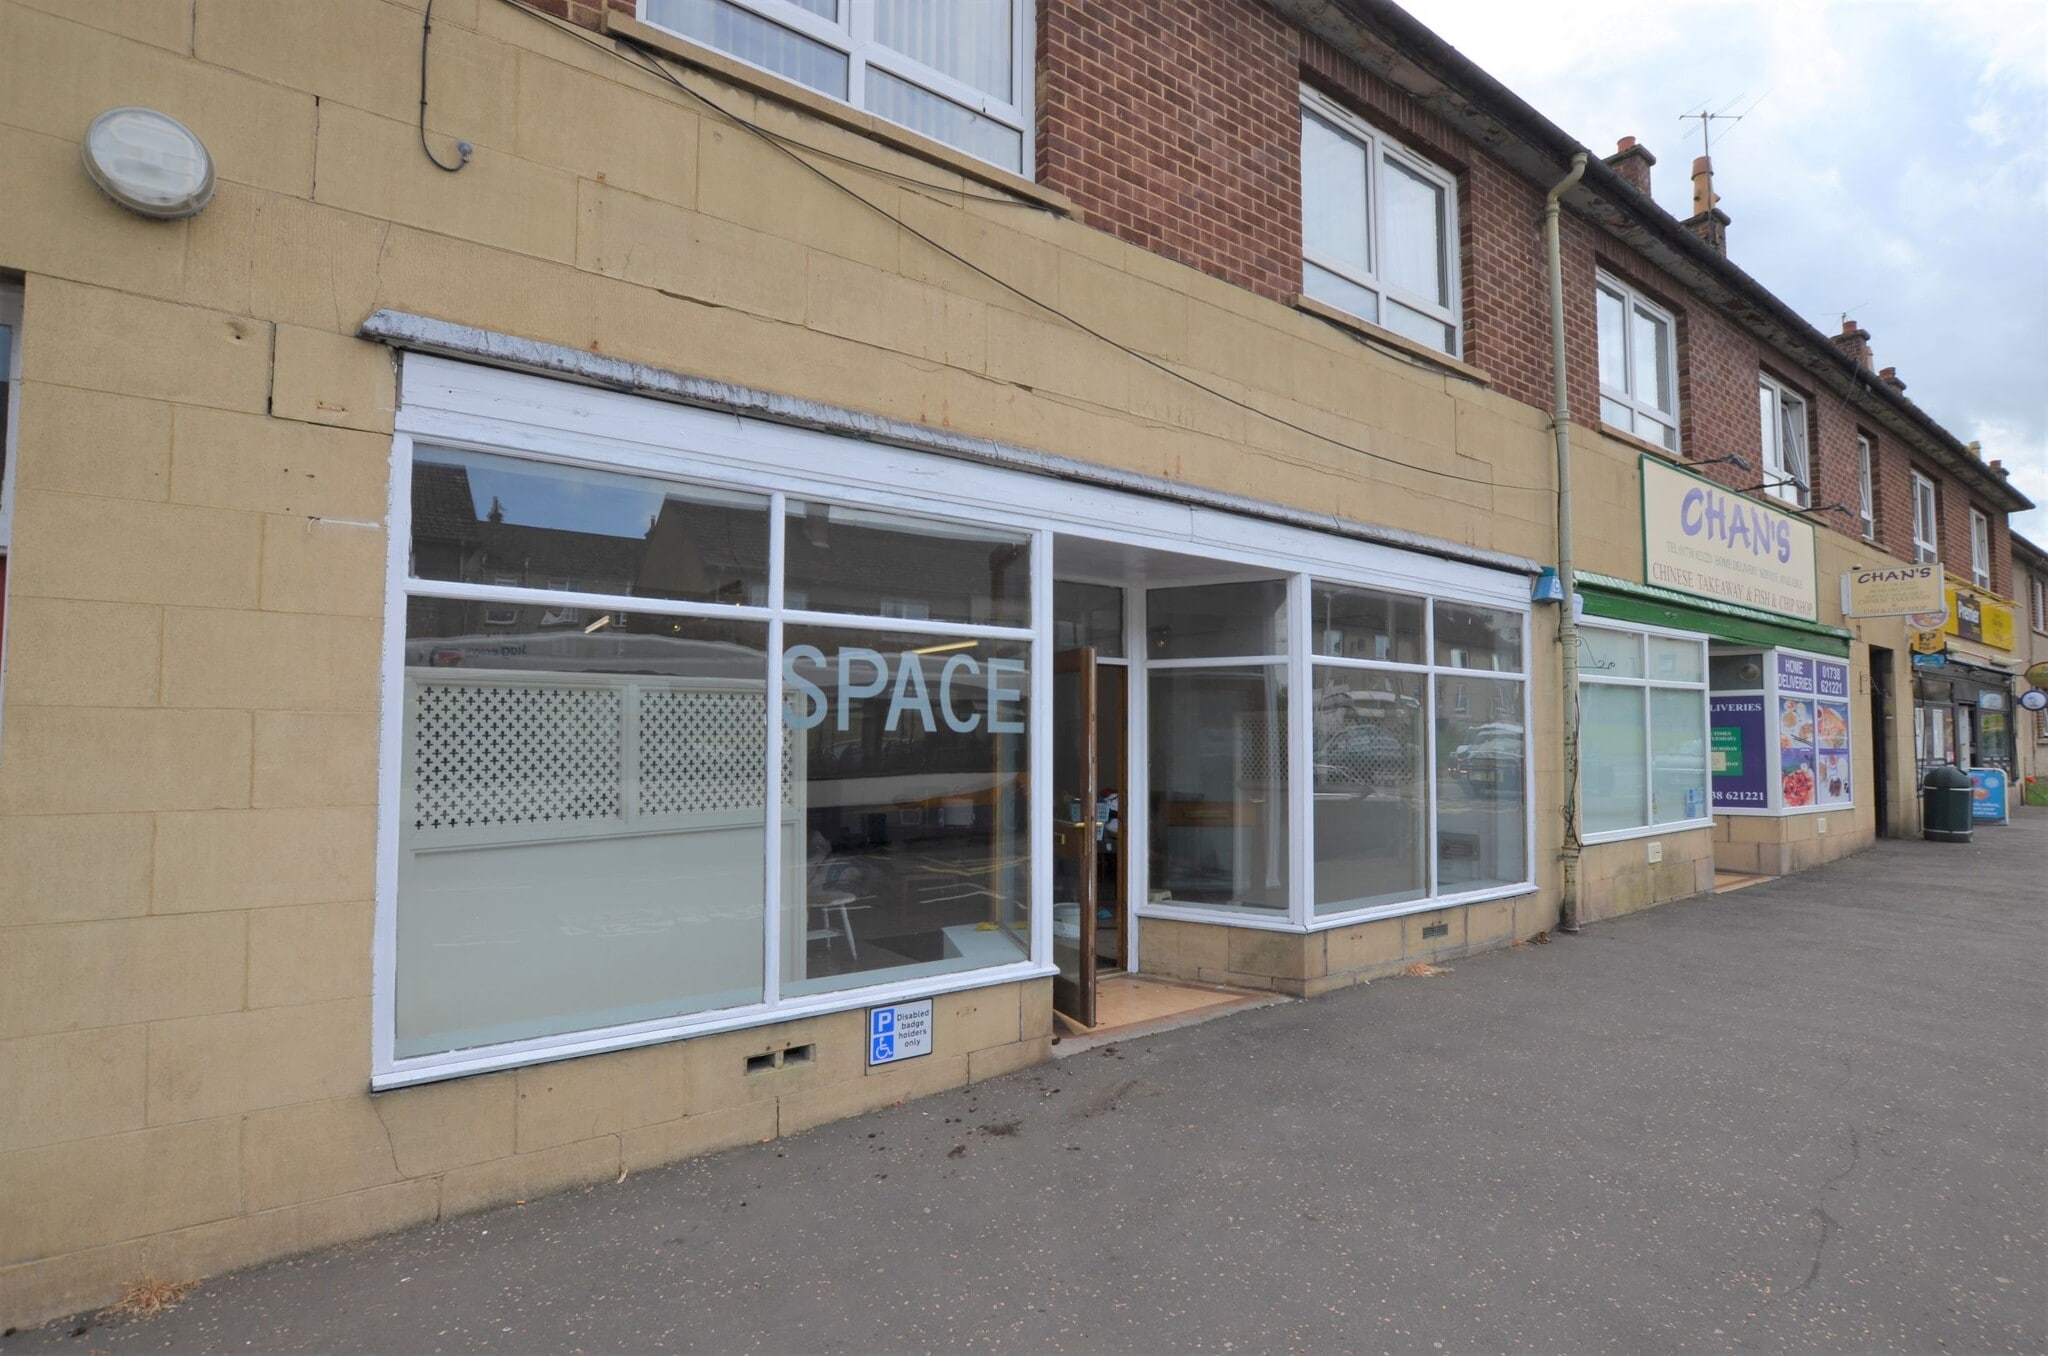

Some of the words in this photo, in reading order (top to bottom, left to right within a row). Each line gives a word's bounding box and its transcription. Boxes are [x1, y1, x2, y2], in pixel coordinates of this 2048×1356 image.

[1681, 487, 1791, 564] CHAN'S
[1858, 567, 1931, 584] CHAN'S
[1652, 562, 1694, 588] CHINESE
[1697, 573, 1744, 600] TAKEAWAY
[1746, 587, 1753, 602] &
[1754, 588, 1770, 606] FISH
[1771, 593, 1777, 608] &
[1778, 594, 1795, 612] CHIP
[1796, 600, 1813, 616] SHOP
[1785, 659, 1803, 675] HOME
[1822, 665, 1841, 681] 01738
[783, 645, 1025, 734] SPACE
[1778, 673, 1813, 691] DELIVERIES
[1820, 680, 1842, 695] 621221
[1725, 791, 1764, 801] 621221
[878, 1012, 892, 1032] P
[896, 1009, 930, 1022] Disabled
[901, 1020, 925, 1030] badge
[898, 1029, 927, 1040] holders
[904, 1038, 921, 1047] only
